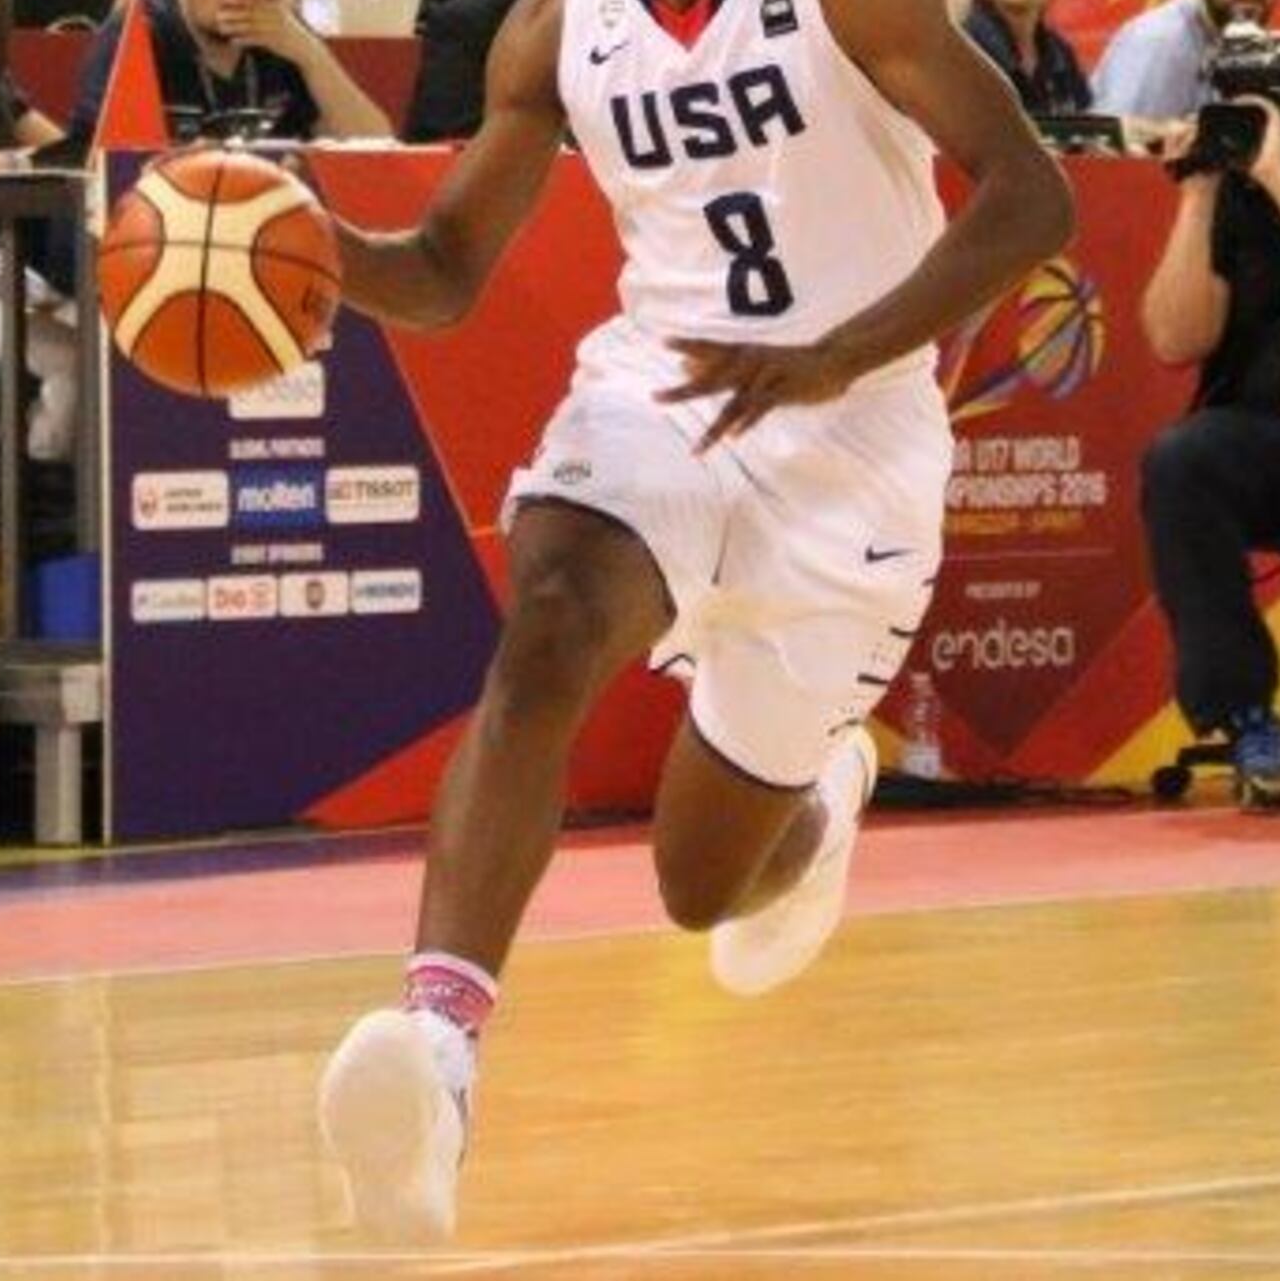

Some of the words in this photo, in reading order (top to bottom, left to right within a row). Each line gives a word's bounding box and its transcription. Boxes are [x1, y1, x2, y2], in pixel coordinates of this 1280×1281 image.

[610, 63, 806, 170] USA
[703, 190, 795, 317] 8
[1013, 434, 1080, 470] WORLD
[237, 480, 316, 512] molten
[355, 480, 415, 499] TISSOT
[1059, 471, 1107, 505] 2016
[932, 619, 1074, 671] endesa
